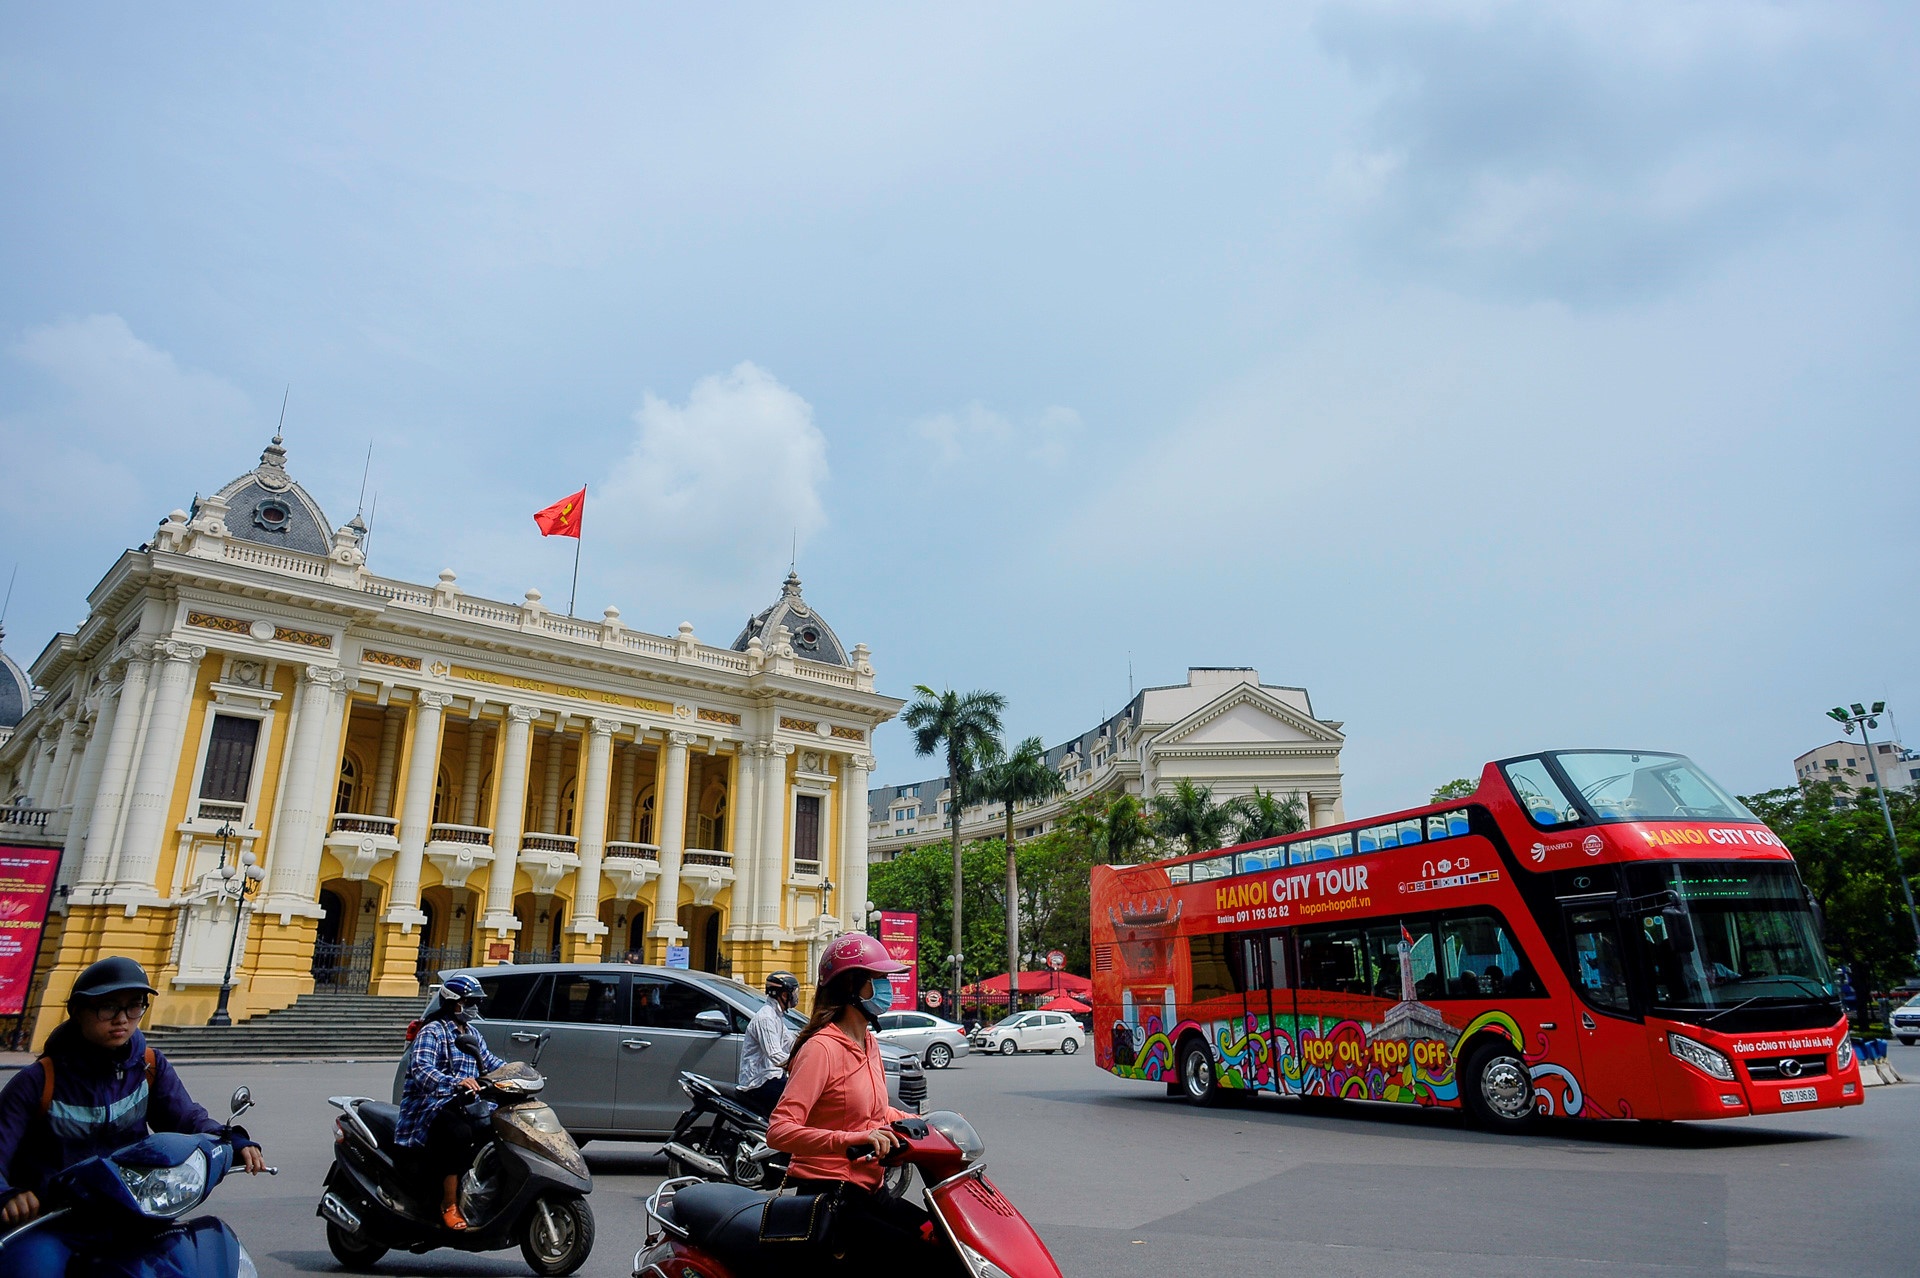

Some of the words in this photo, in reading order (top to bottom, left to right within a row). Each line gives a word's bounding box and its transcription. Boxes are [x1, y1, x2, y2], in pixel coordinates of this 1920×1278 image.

[512, 678, 545, 691] HÁT
[1641, 828, 1711, 848] HANOI
[1708, 828, 1748, 845] CITY
[1216, 881, 1268, 910] HANOI
[1272, 874, 1311, 903] CITY
[1316, 865, 1368, 895] TOUR
[1236, 910, 1250, 922] 091
[1252, 908, 1266, 920] 193
[1267, 906, 1278, 918] 82
[1279, 905, 1289, 917] 82
[1300, 896, 1371, 915] hopon-hopoff.vn
[1303, 1040, 1334, 1065] HOP
[1338, 1041, 1363, 1067] ON
[1373, 1042, 1408, 1068] HOP
[1414, 1043, 1446, 1065] OFF
[1733, 1040, 1755, 1053] TỔNG
[1756, 1040, 1778, 1051] CÔNG
[1778, 1041, 1787, 1049] TY
[1787, 1039, 1802, 1050] VẬN
[1802, 1037, 1812, 1048] TẢI
[1812, 1037, 1822, 1047] HÀ
[1822, 1036, 1834, 1048] NỘI
